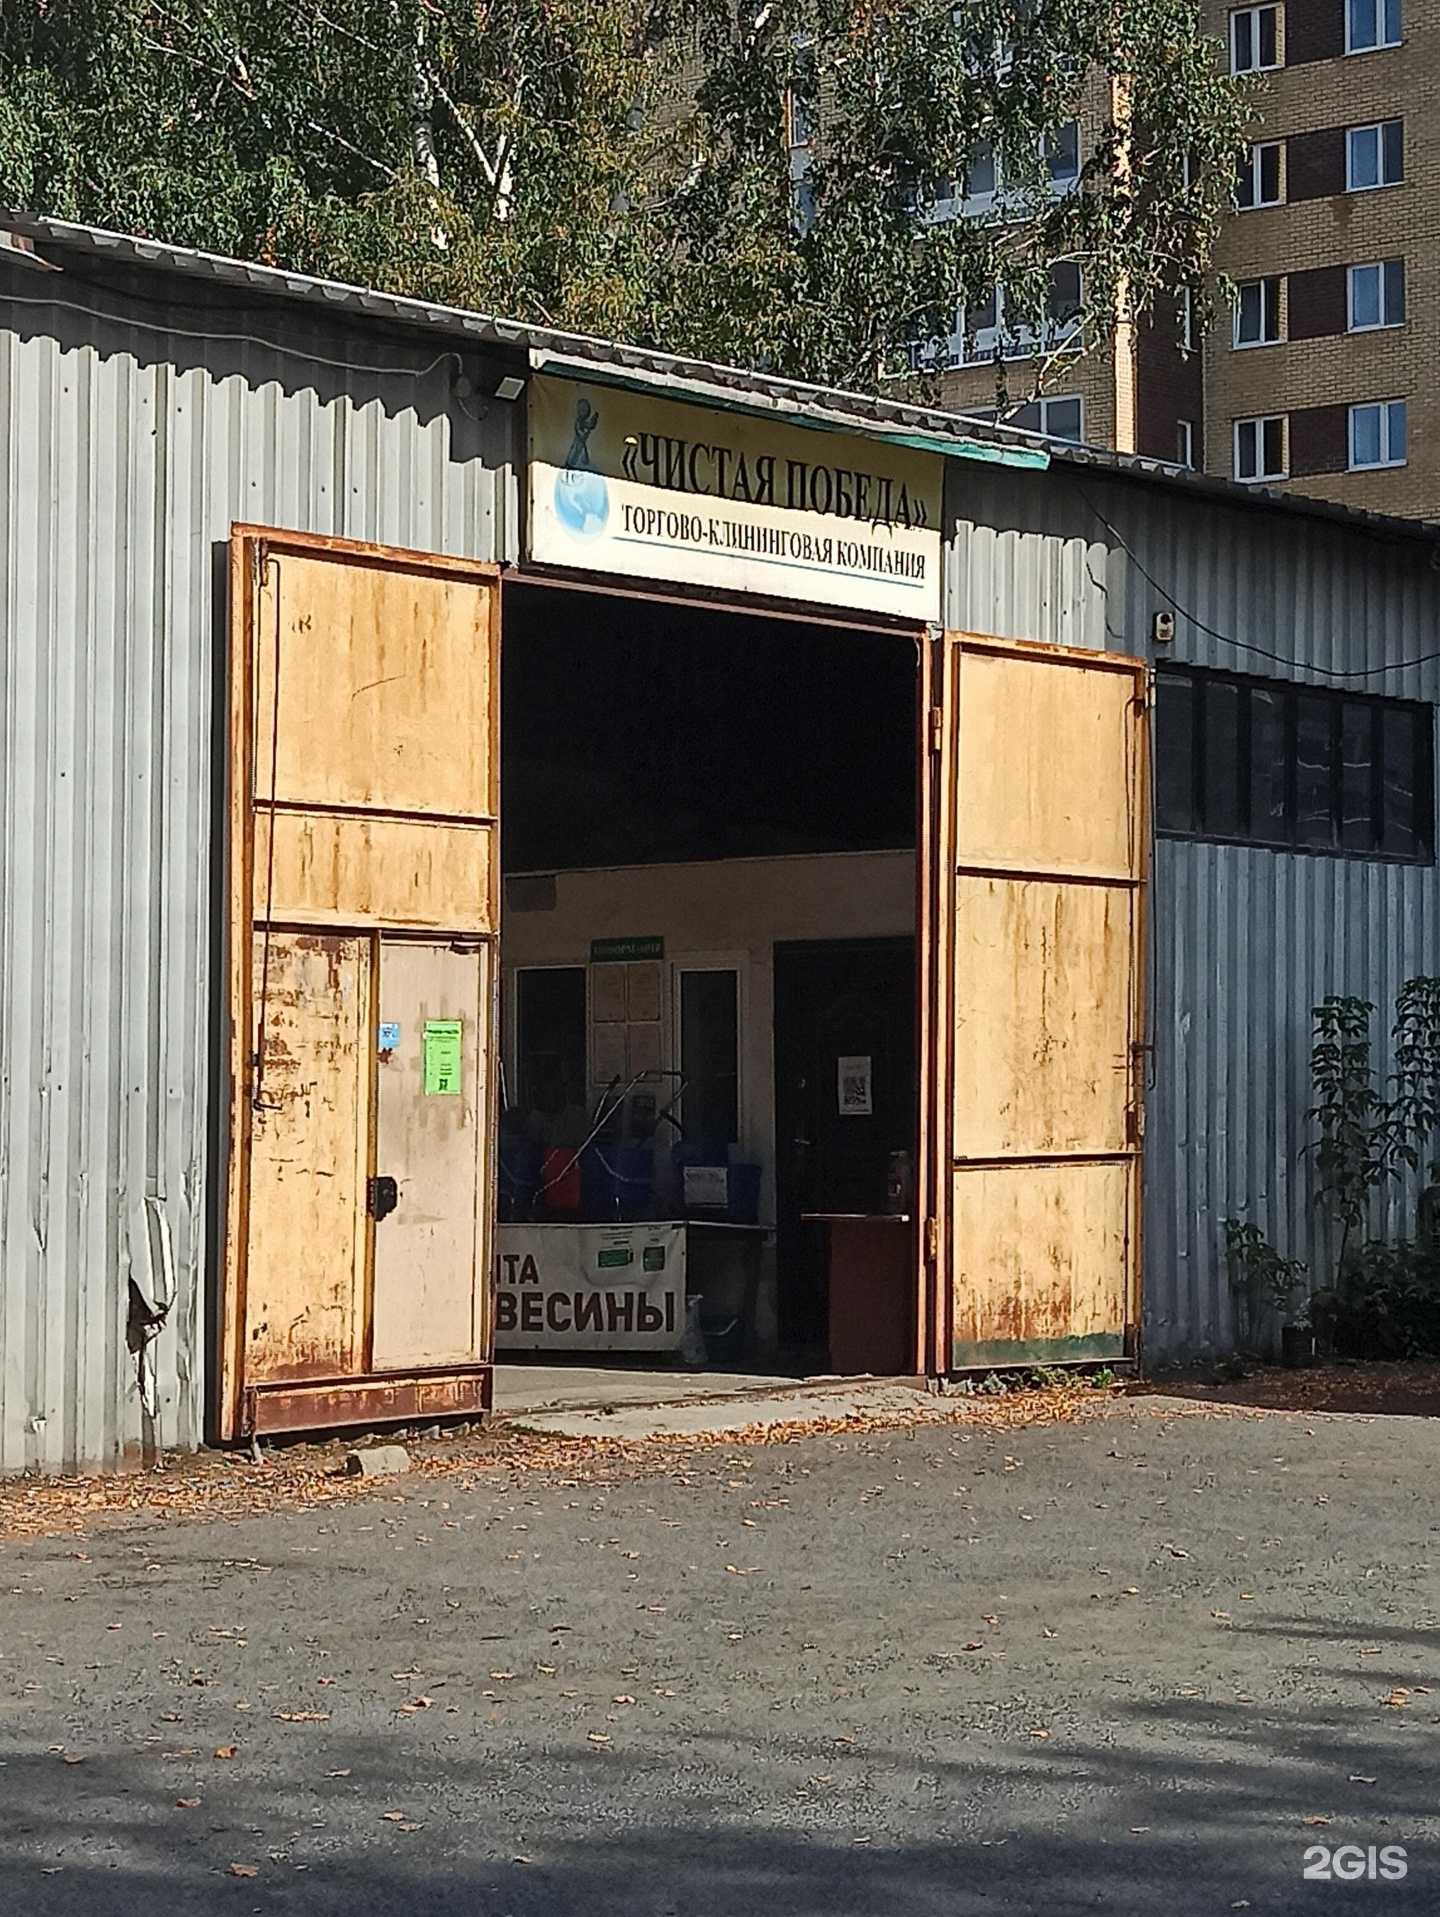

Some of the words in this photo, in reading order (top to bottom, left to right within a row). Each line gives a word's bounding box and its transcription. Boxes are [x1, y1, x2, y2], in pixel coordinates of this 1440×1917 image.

[621, 432, 776, 506] «ЧИСТАЯ
[785, 459, 928, 539] ПОБЕДА»
[620, 504, 833, 564] ТОРГОВО-КЛИНИНГОВАЯ
[836, 540, 926, 580] КОМПАНИЯ
[496, 1291, 675, 1333] ВЕСИНЫ
